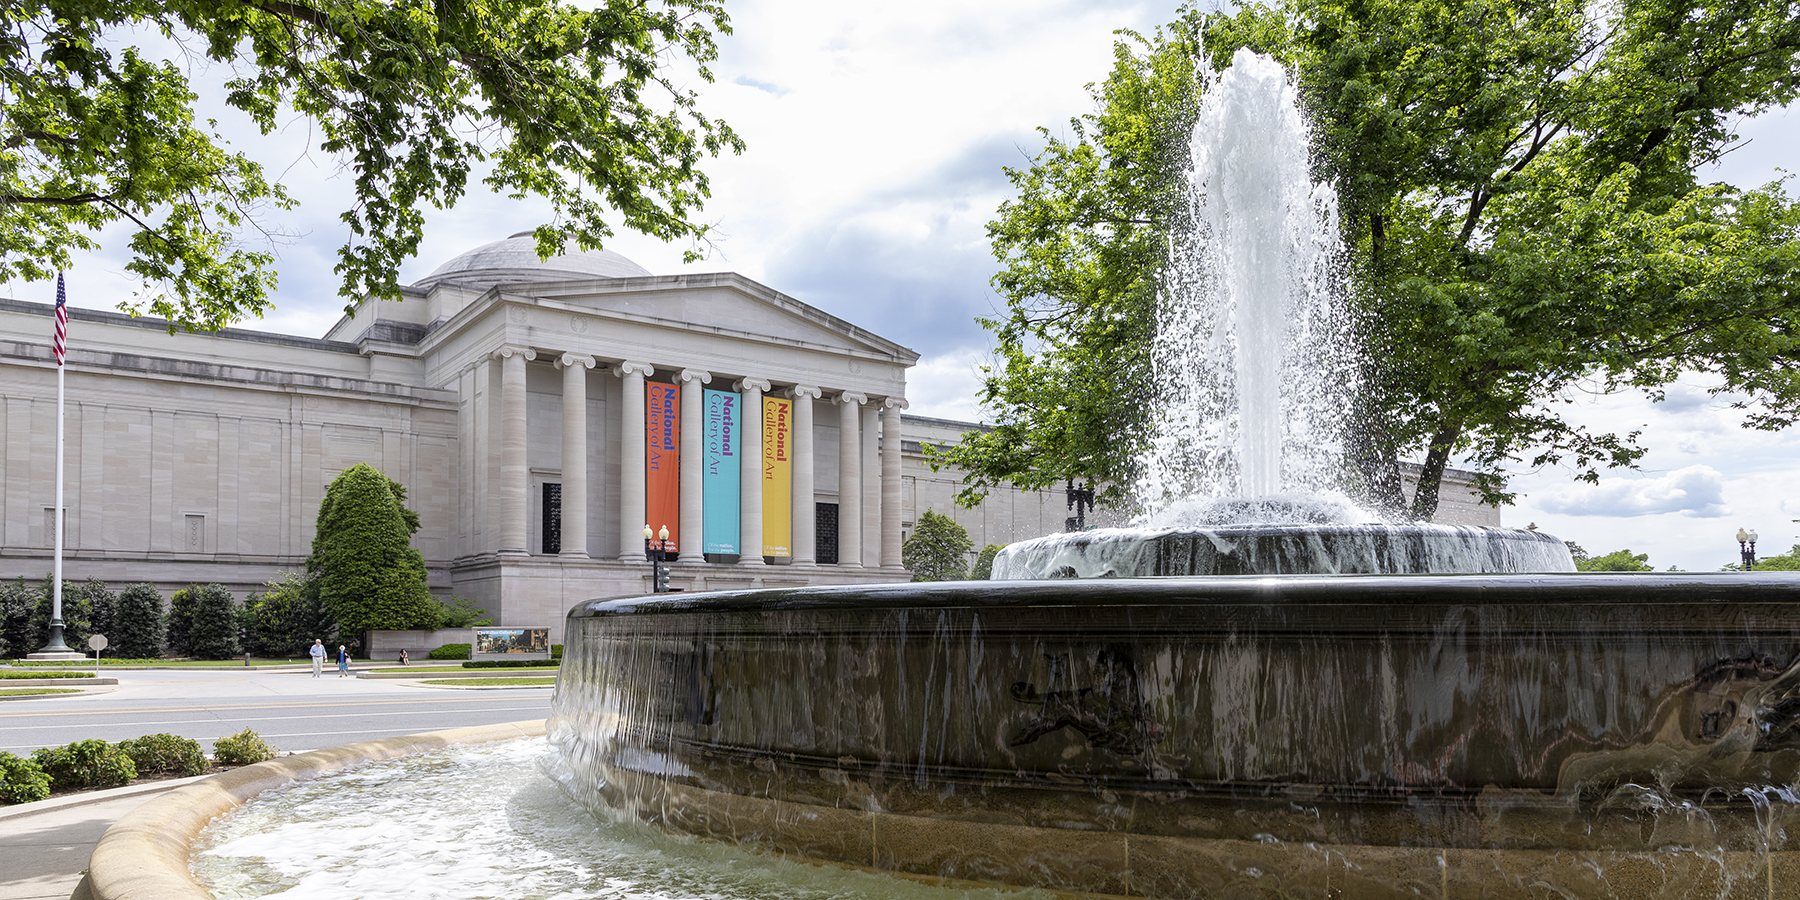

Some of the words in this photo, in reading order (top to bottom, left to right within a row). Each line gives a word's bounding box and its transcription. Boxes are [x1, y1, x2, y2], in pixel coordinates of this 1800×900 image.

[648, 386, 662, 434] Gallery
[664, 388, 676, 450] National
[708, 394, 722, 441] Gallery
[723, 396, 734, 456] National
[764, 401, 777, 446] Gallery
[651, 436, 662, 450] of
[777, 403, 788, 461] National
[651, 450, 661, 470] Art
[710, 442, 721, 456] of
[766, 448, 775, 461] of
[710, 456, 720, 476] Art
[766, 461, 774, 480] Art
